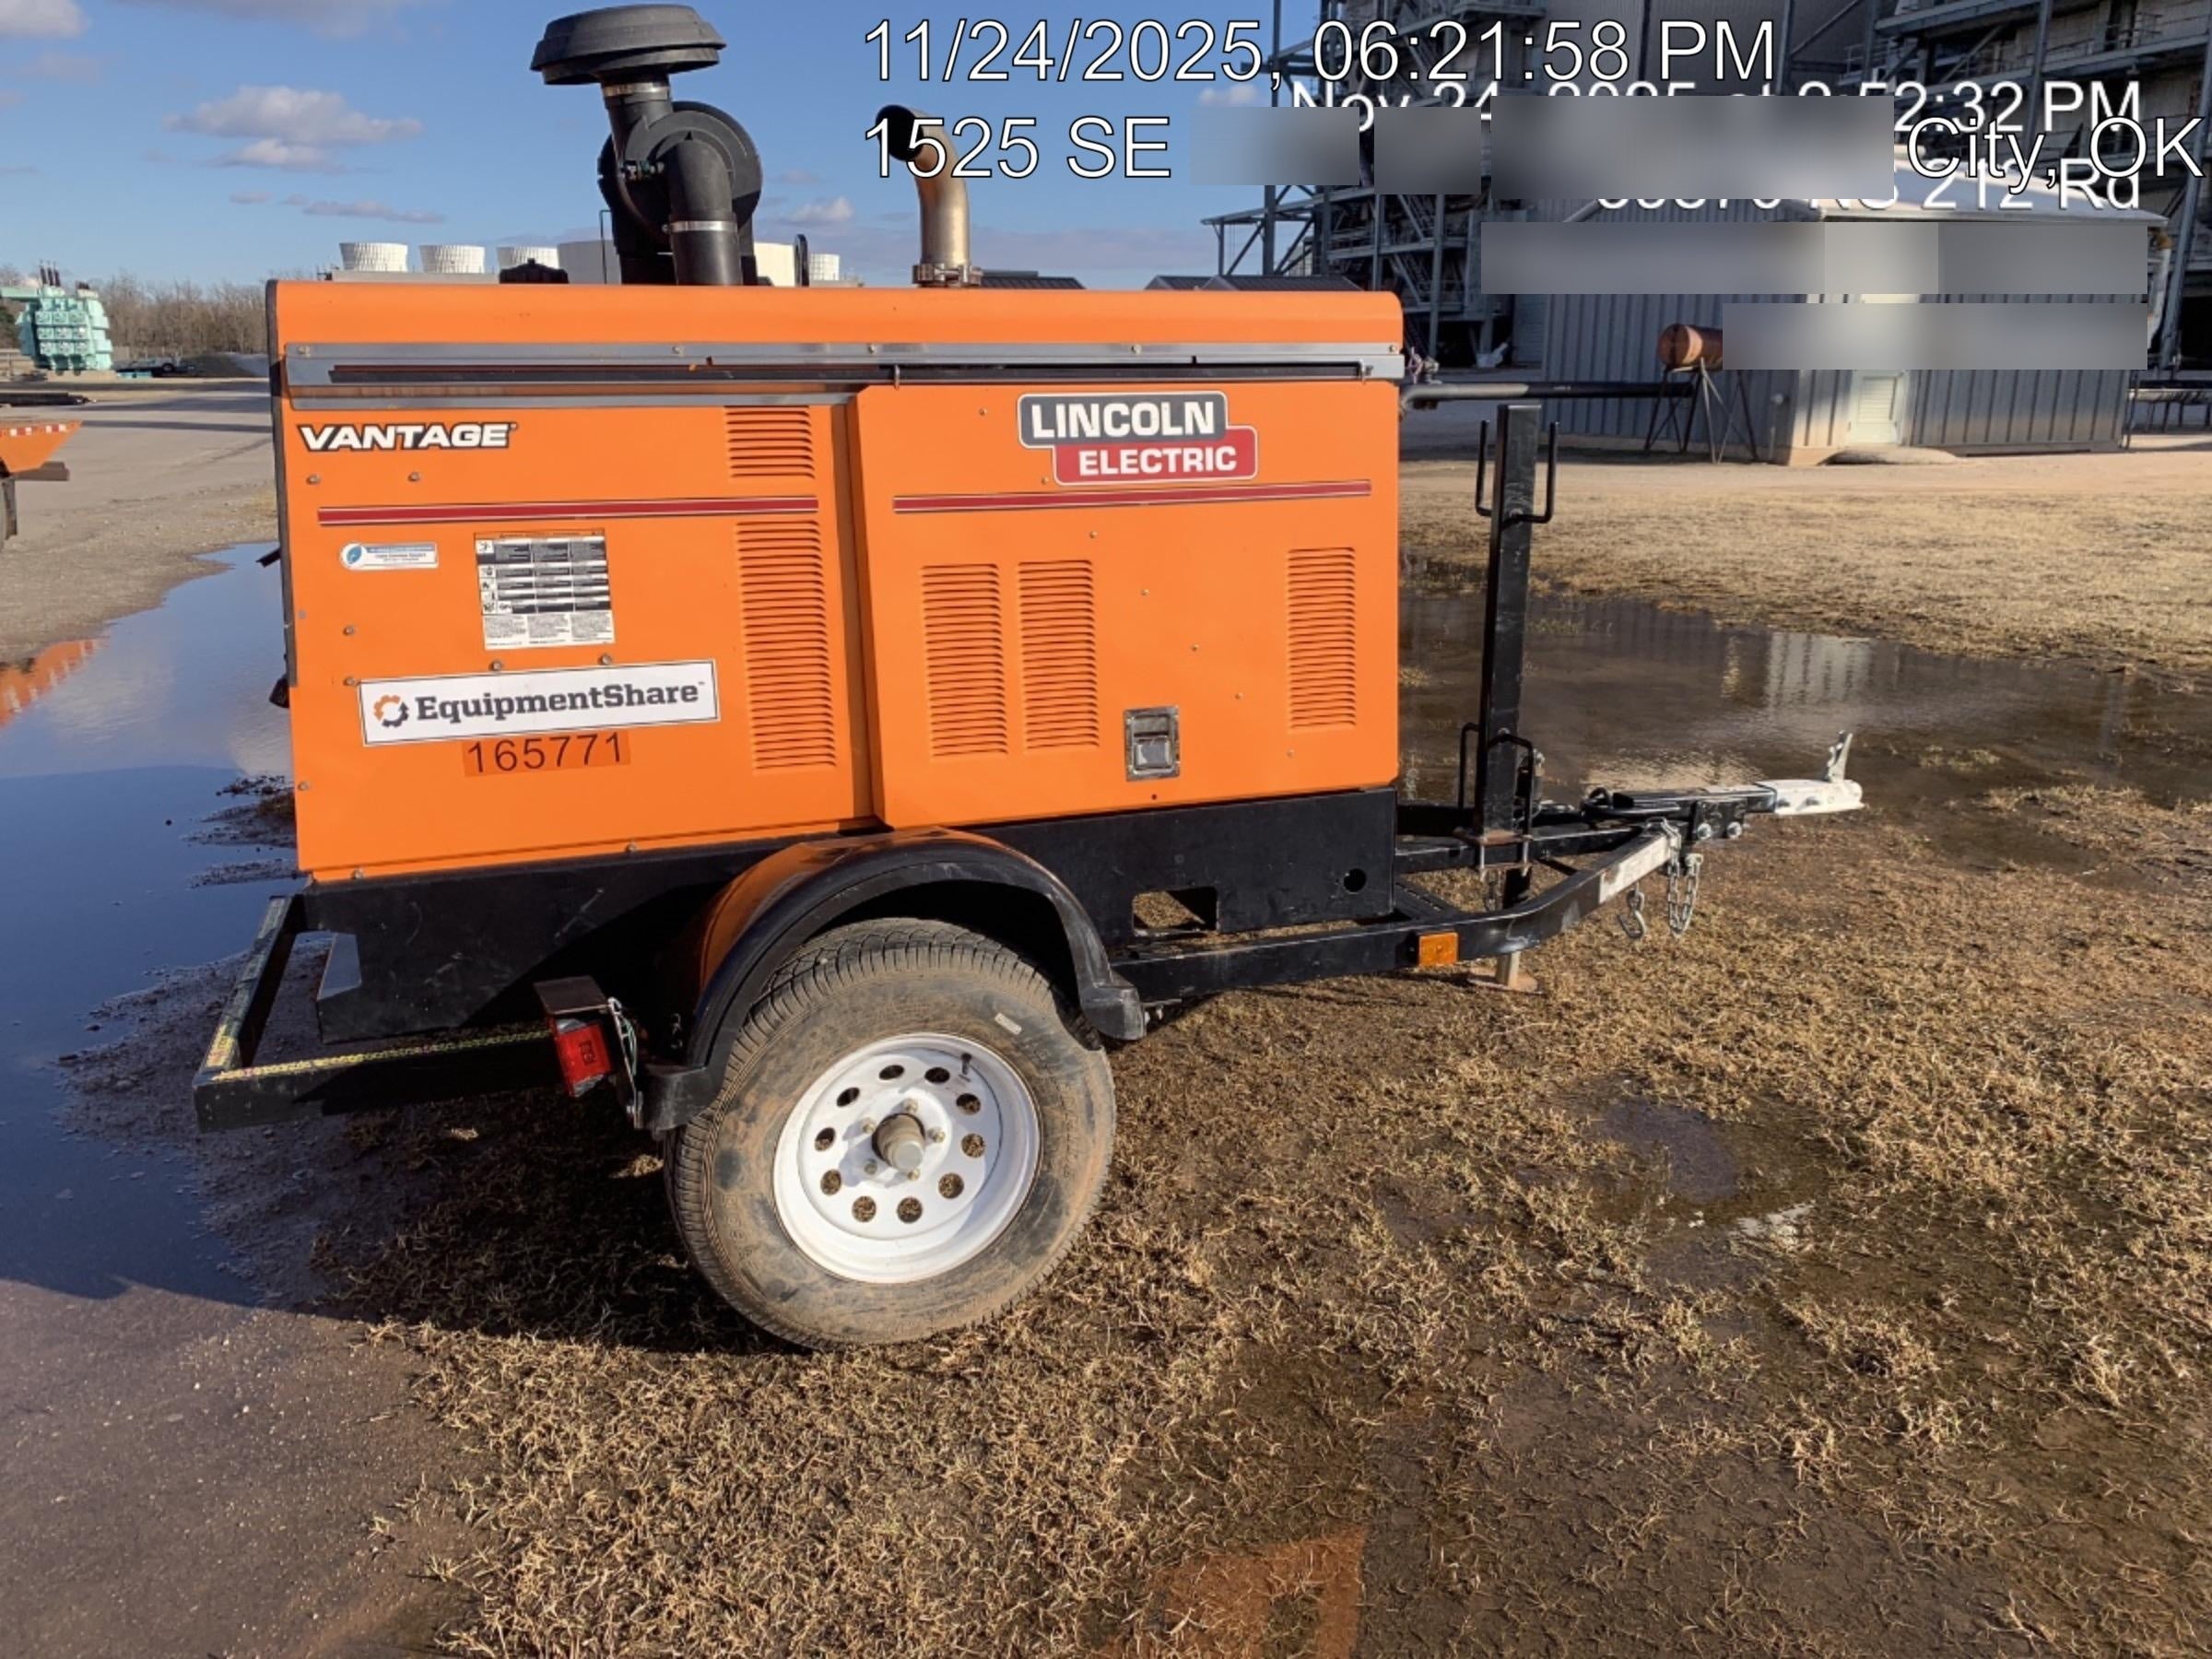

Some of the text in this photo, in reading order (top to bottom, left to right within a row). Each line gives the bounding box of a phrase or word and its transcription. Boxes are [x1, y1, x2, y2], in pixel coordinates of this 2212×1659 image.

[299, 422, 512, 451] VANTAGE
[1030, 400, 1215, 439] LINCOLN
[1078, 445, 1238, 477] ELECTRIC
[415, 684, 700, 724] EquipmentShare
[467, 732, 621, 773] 165771
